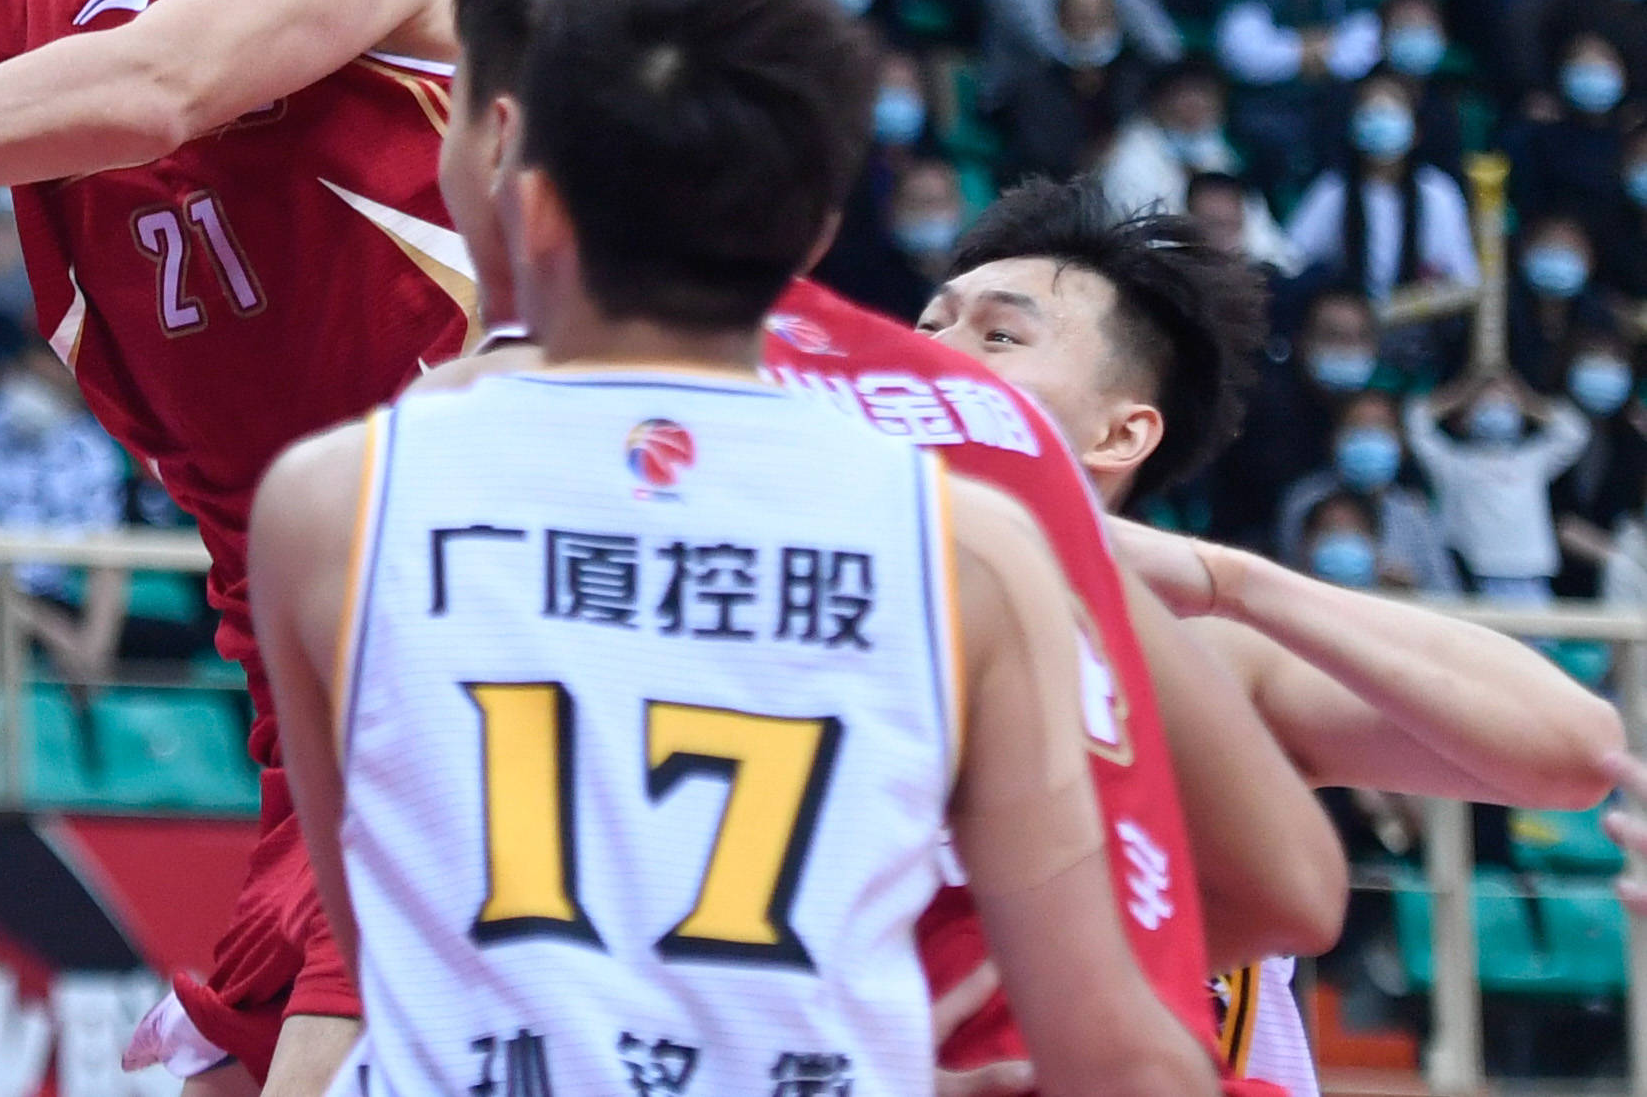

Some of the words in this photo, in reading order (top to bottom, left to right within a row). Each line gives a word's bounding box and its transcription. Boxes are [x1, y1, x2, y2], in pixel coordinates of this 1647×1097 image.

[133, 194, 262, 334] 21
[428, 524, 875, 650] 广厦控股
[458, 680, 845, 975] 17
